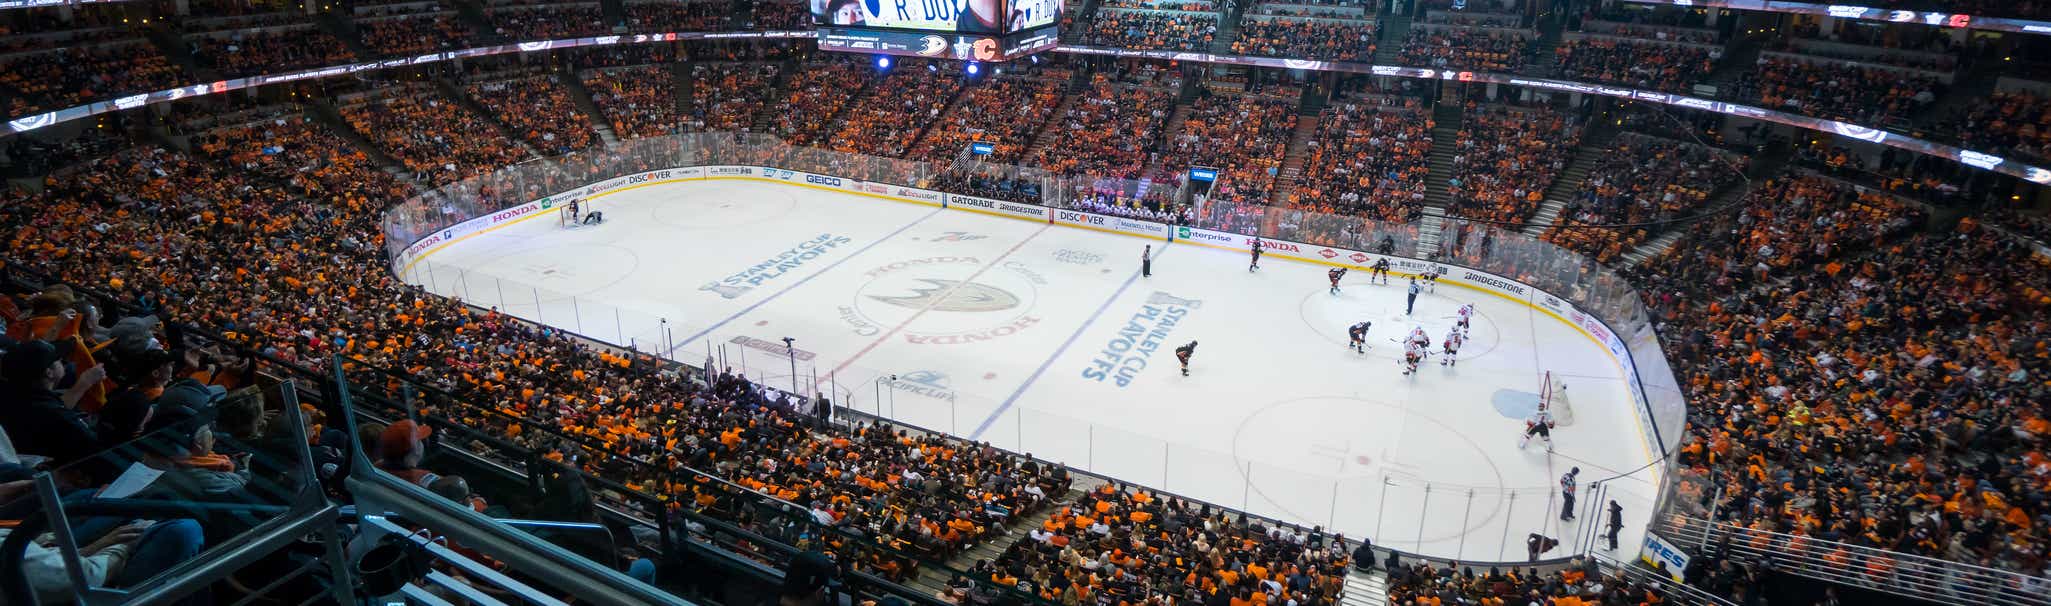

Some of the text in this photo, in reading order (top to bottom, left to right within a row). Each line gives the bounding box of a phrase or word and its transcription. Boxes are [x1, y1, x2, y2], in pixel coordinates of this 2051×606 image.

[629, 171, 671, 184] DISCOVER
[806, 174, 841, 187] GEICO
[951, 196, 994, 209] GATORADE
[999, 203, 1043, 215] BRIDGESTONE
[493, 204, 539, 223] HONDA
[1060, 211, 1104, 225] DISCOVER
[1179, 227, 1232, 242] enterprise
[408, 236, 441, 258] HONDA
[749, 235, 851, 287] PLAYOFFS
[1464, 271, 1525, 295] BRIDGESTONE
[1081, 304, 1162, 382] PLAYOFFS
[1112, 305, 1188, 388] STANLEY CUP
